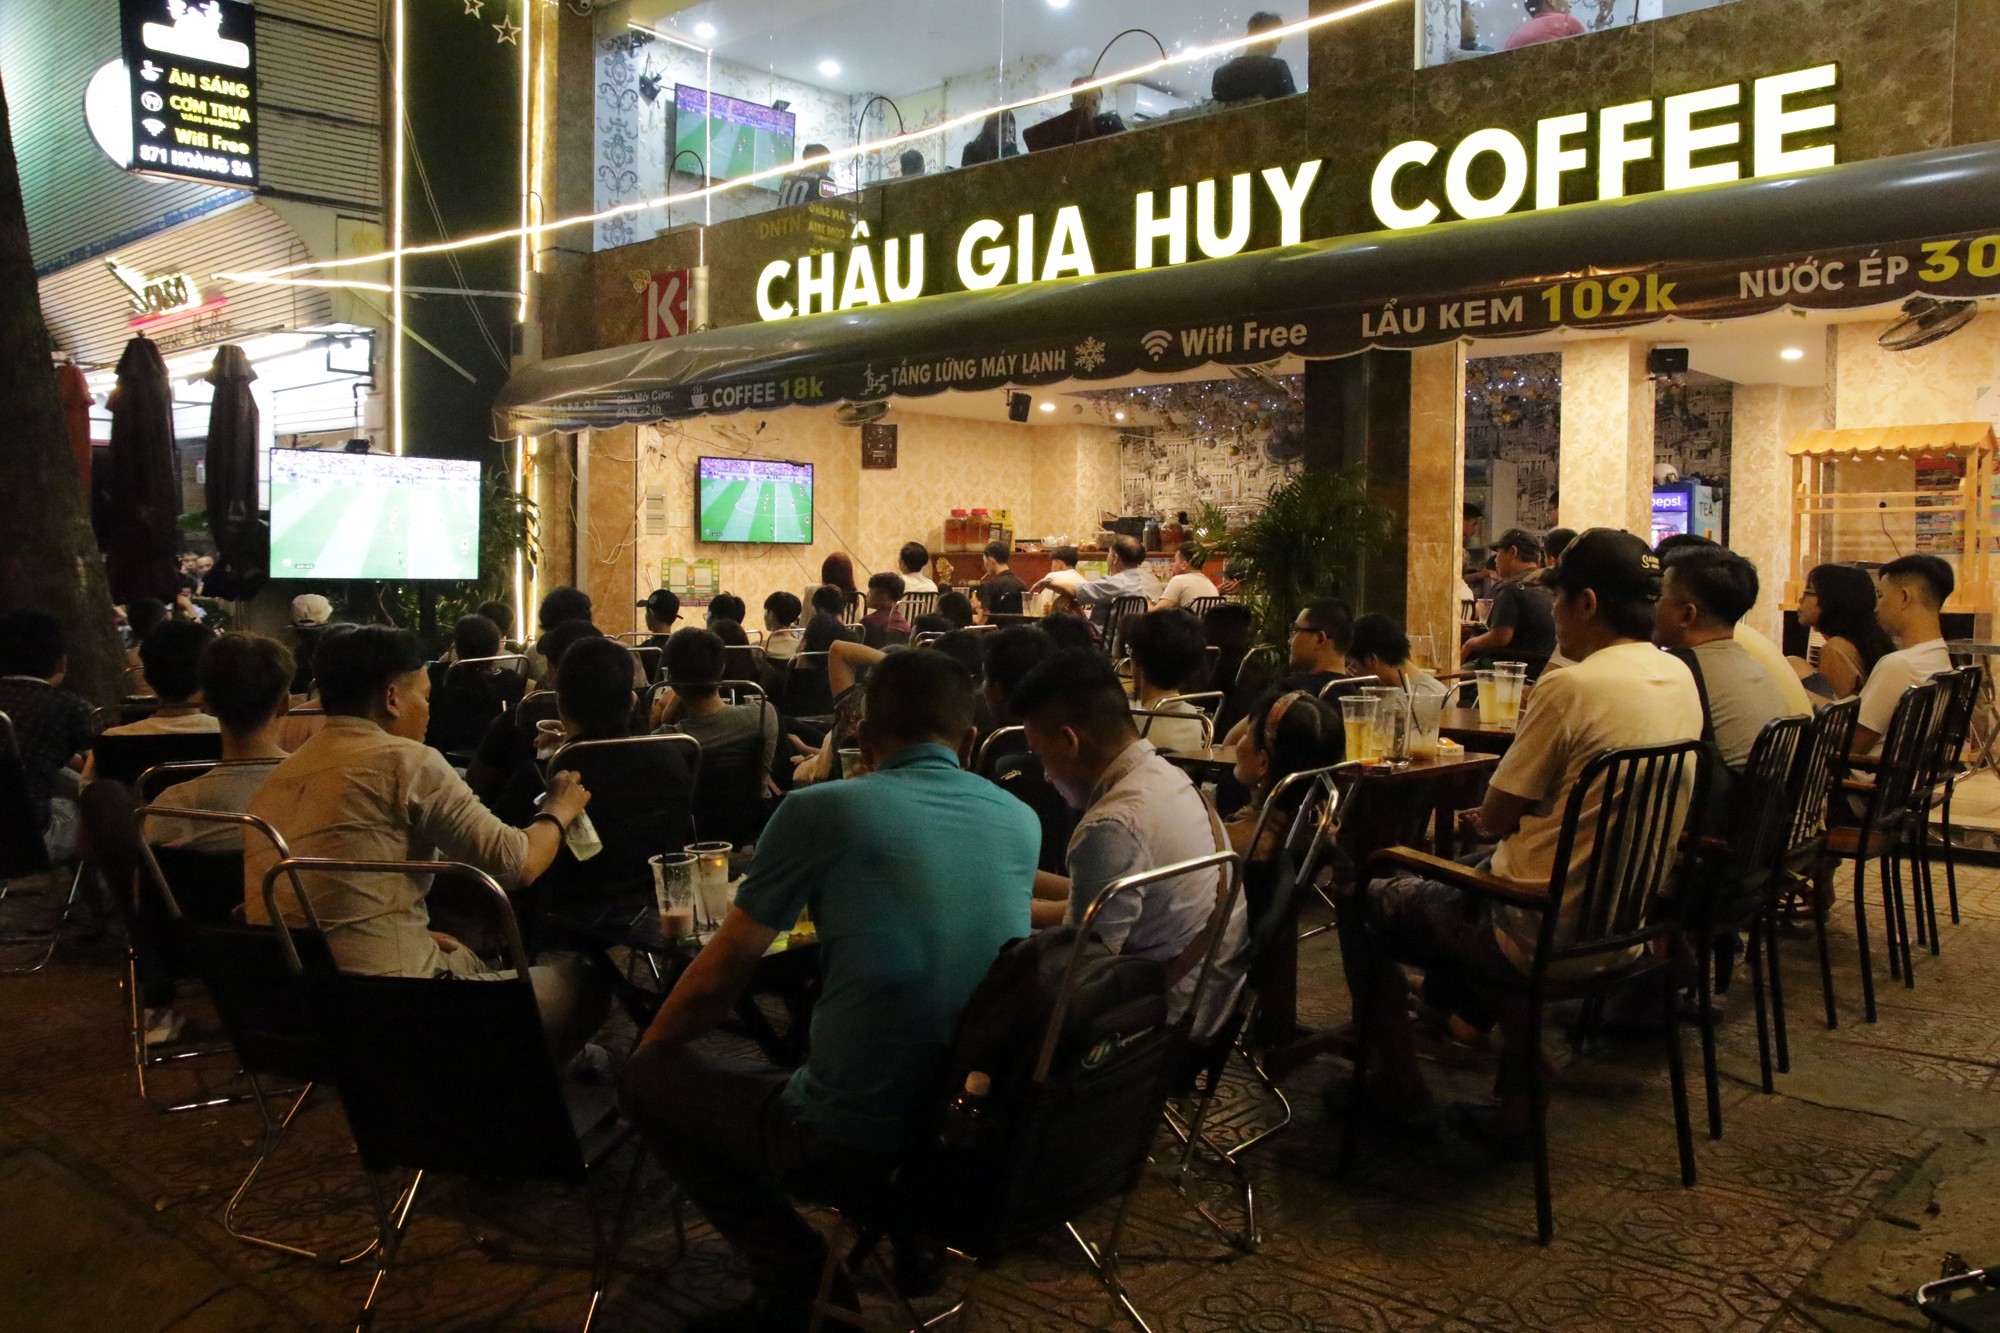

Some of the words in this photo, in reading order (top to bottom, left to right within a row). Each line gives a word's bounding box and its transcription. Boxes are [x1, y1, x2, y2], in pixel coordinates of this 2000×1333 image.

[199, 75, 250, 99] SÁNG
[169, 95, 208, 115] CƠM
[210, 103, 251, 123] TRƯA
[174, 127, 209, 148] Wifi
[212, 134, 250, 155] Free
[171, 149, 230, 175] HOÀNG
[231, 160, 253, 178] SA
[756, 219, 925, 322] CHÂU
[956, 205, 1096, 291] GIA
[1134, 158, 1323, 270] HUY
[1370, 63, 1838, 231] COFFEE
[778, 179, 810, 208] 10
[1739, 255, 1846, 300] NƯỚC
[1858, 248, 1910, 288] ÉP
[1361, 297, 1426, 338] LẨU
[1439, 295, 1524, 330] KEM
[1541, 273, 1678, 323] 109k
[1181, 324, 1234, 357] Wifi
[1243, 321, 1308, 351] Free
[981, 349, 1018, 378] MÁY
[1022, 349, 1067, 379] LẠNH
[712, 382, 776, 409] COFFEE
[780, 376, 825, 400] 18k
[645, 403, 663, 416] 24h
